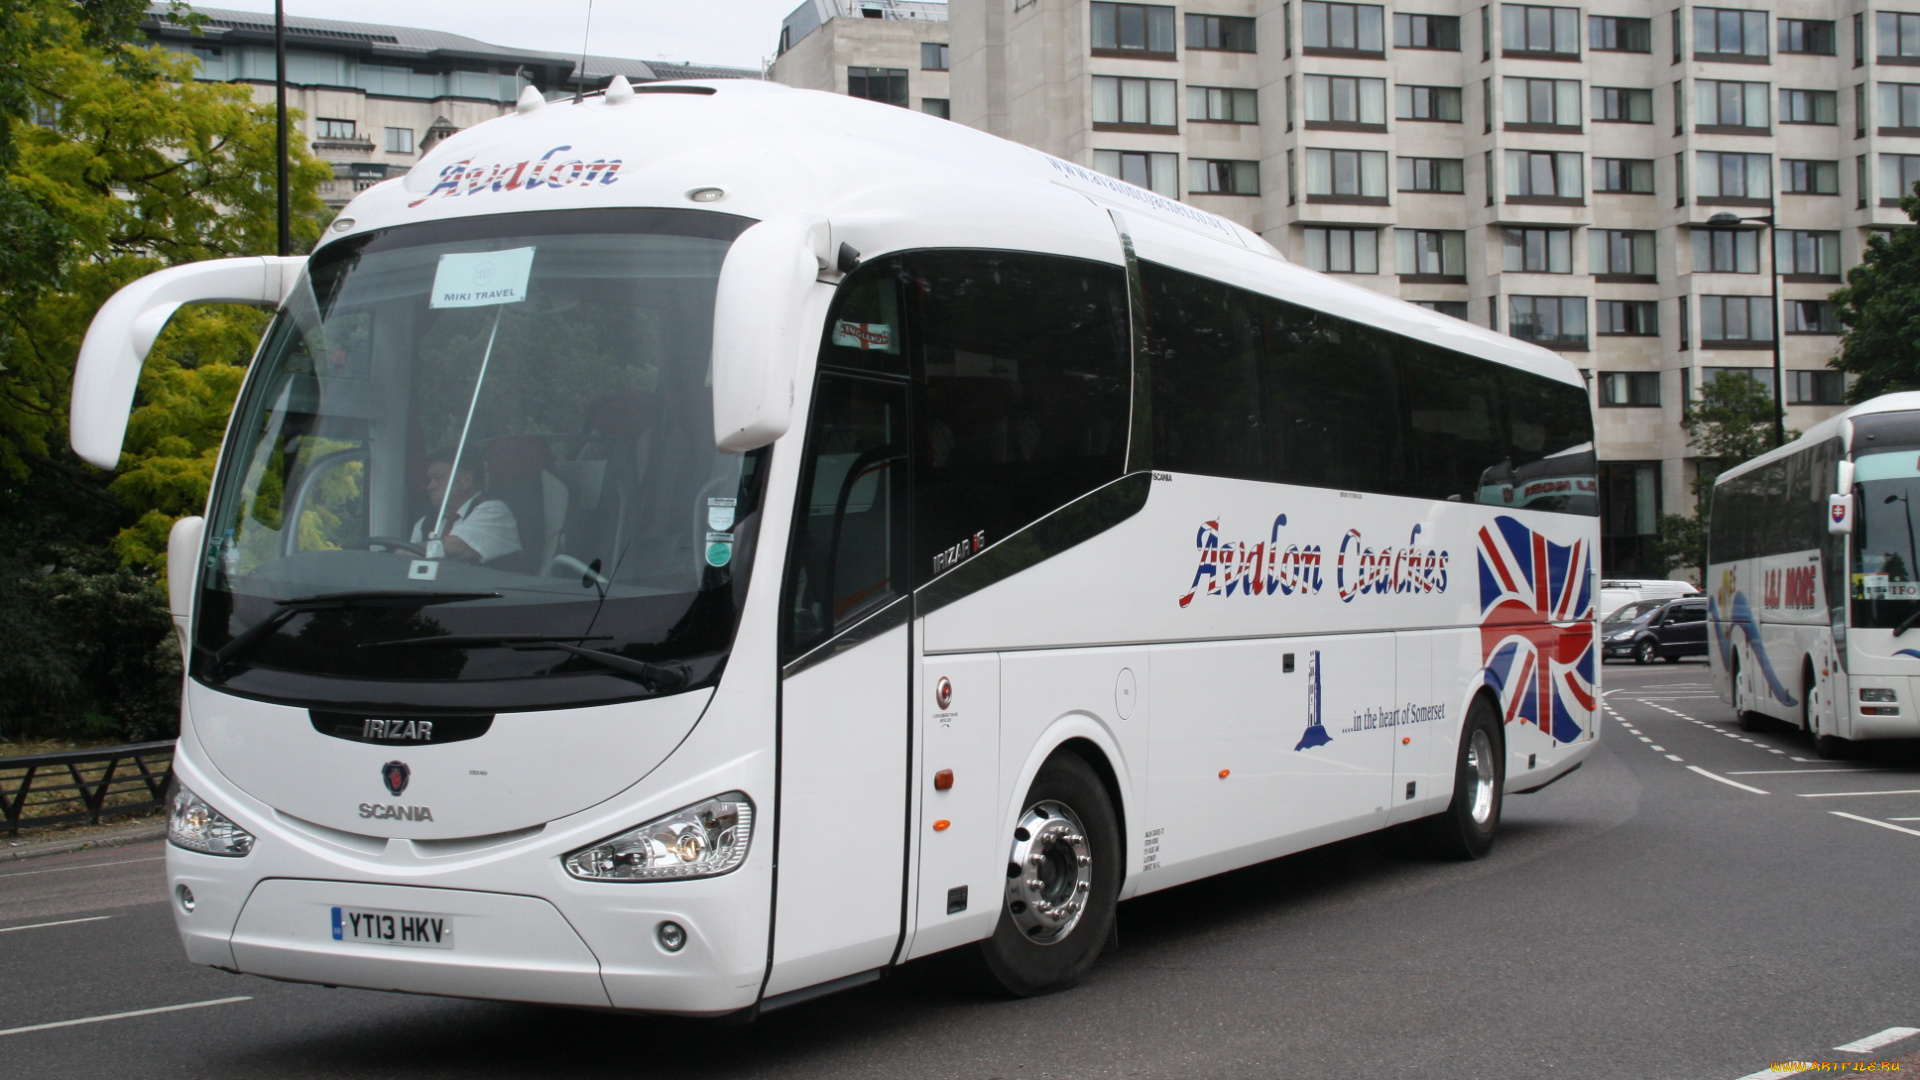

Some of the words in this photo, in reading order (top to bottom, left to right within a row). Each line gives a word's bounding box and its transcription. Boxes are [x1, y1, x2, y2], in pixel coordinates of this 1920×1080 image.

[408, 145, 623, 208] Avalon
[444, 293, 472, 302] MIKI
[475, 288, 515, 300] TRAVEL
[845, 325, 883, 344] ENGLAND
[1152, 472, 1172, 482] SCANIA
[933, 538, 970, 575] IRIZAR
[972, 529, 985, 552] i6
[1179, 513, 1323, 608] Avalon
[1337, 523, 1449, 604] Coaches
[1784, 565, 1816, 610] MORE
[362, 718, 433, 741] IRIZAR
[1364, 707, 1377, 730] the
[1379, 706, 1400, 728] heart
[1402, 702, 1410, 724] of
[1411, 702, 1445, 723] Somerset
[358, 802, 434, 822] SCANIA
[349, 912, 395, 940] YT13
[401, 916, 443, 943] HKV
